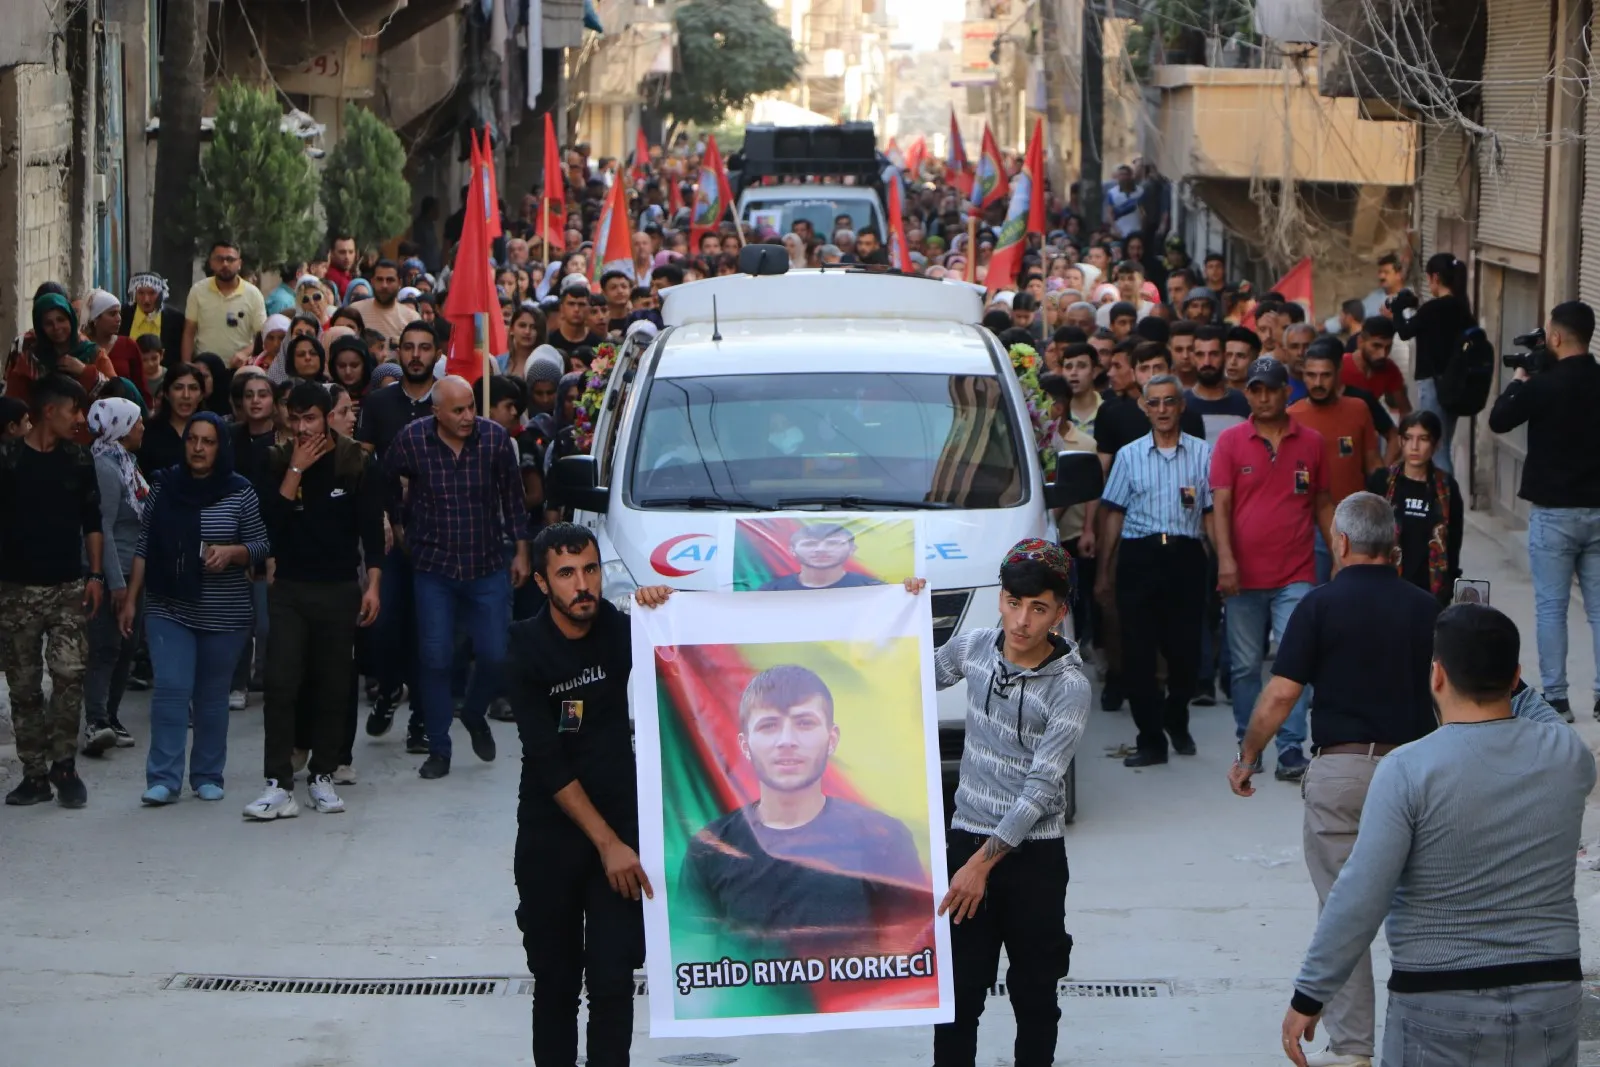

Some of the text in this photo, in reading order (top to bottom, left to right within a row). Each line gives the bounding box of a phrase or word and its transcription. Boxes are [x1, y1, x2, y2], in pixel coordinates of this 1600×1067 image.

[677, 949, 934, 994] ŞEHÎD RIYAD KORKECÎ
